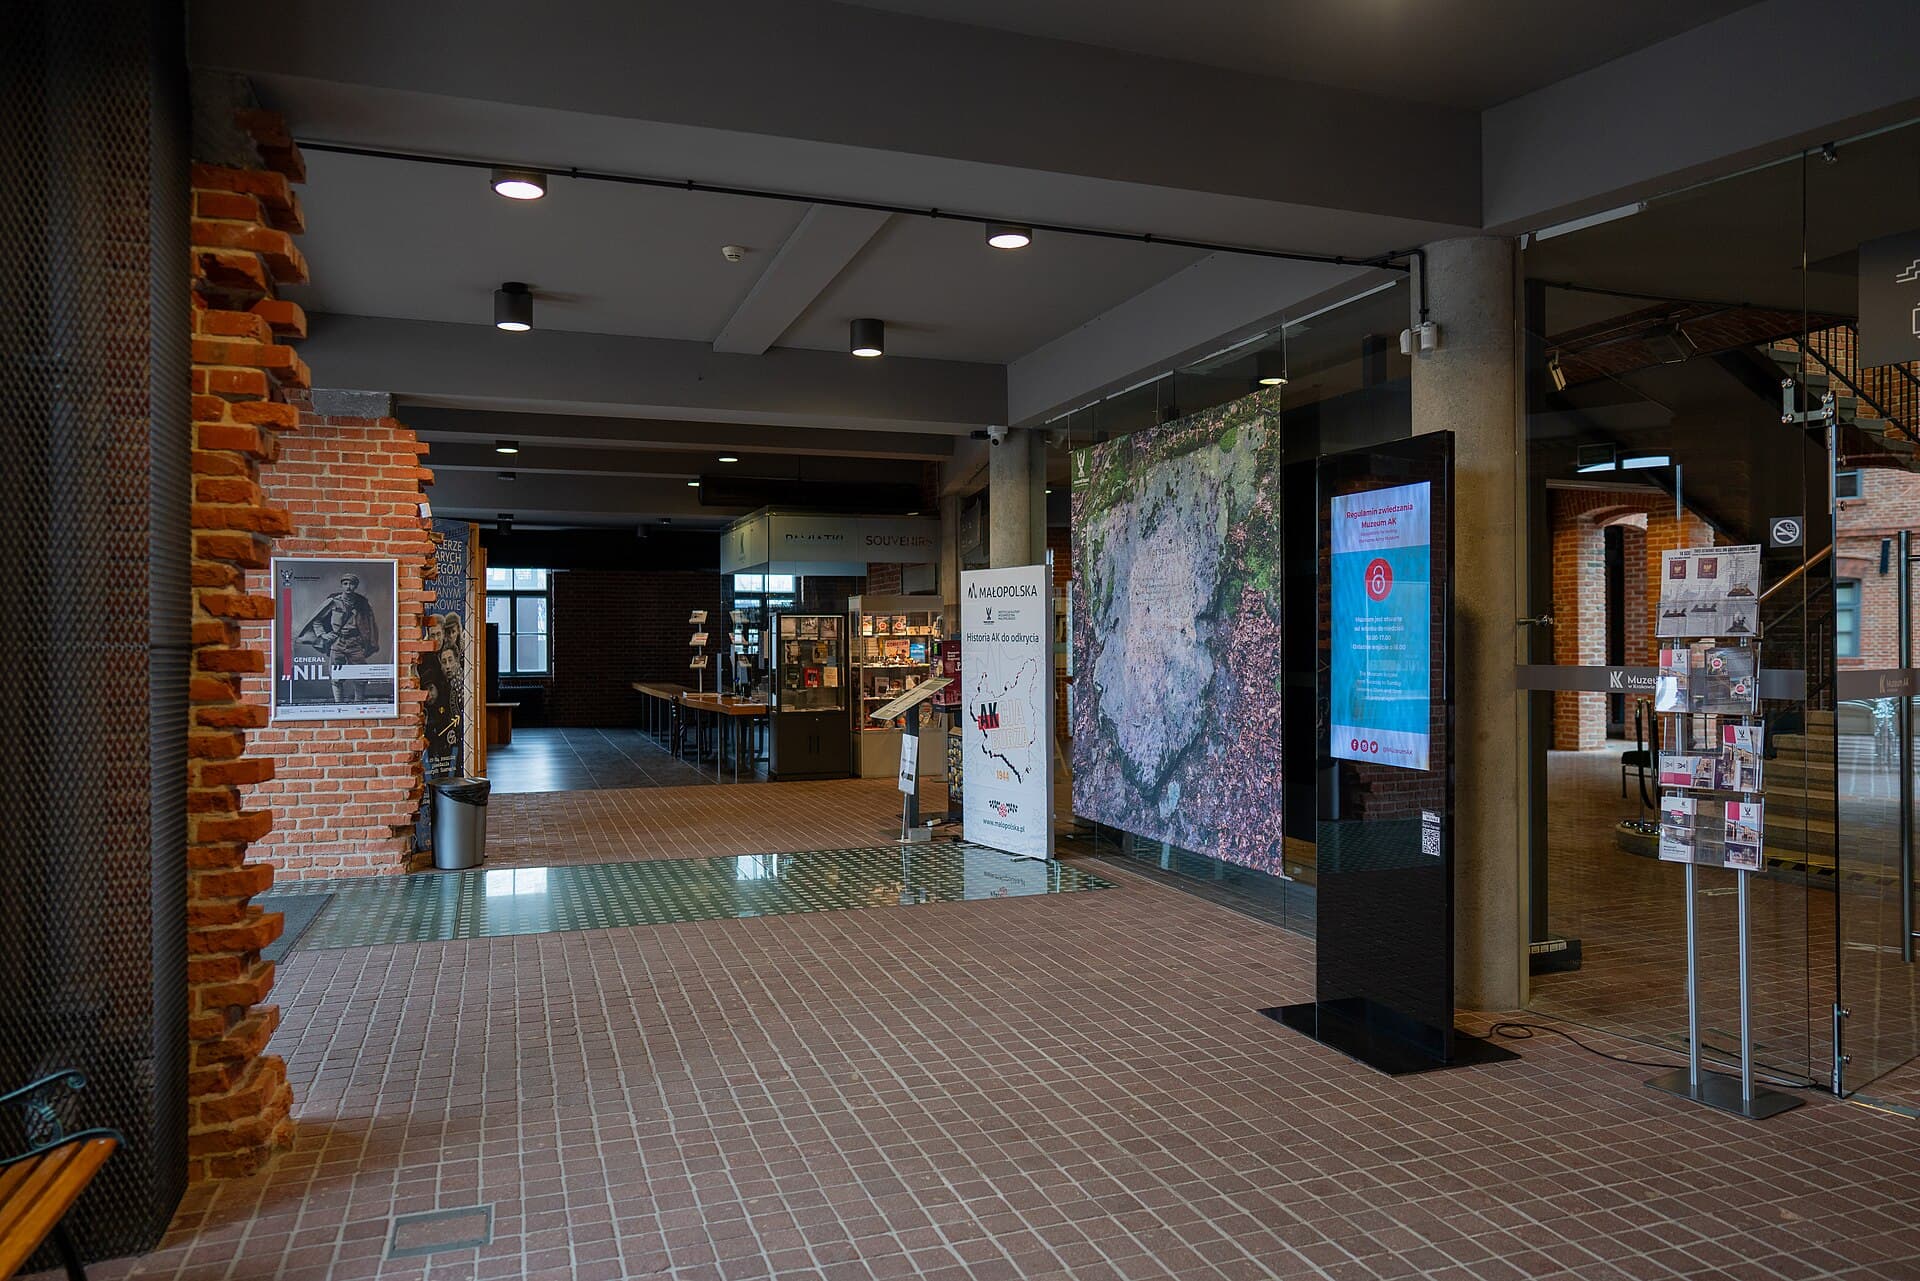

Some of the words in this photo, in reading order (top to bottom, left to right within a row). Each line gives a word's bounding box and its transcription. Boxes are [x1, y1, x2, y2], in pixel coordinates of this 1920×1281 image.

[1346, 508, 1378, 520] Regulamin
[1378, 502, 1414, 515] zwiedzania
[1361, 519, 1387, 529] Muzeum
[1387, 518, 1397, 527] AK
[435, 550, 462, 563] ARYCH
[979, 584, 1038, 598] MAŁOPOLSKA
[966, 632, 990, 643] Historia
[991, 633, 1001, 643] AK
[1001, 633, 1010, 643] do
[1011, 633, 1039, 645] odkrycia
[996, 769, 1009, 781] 1944
